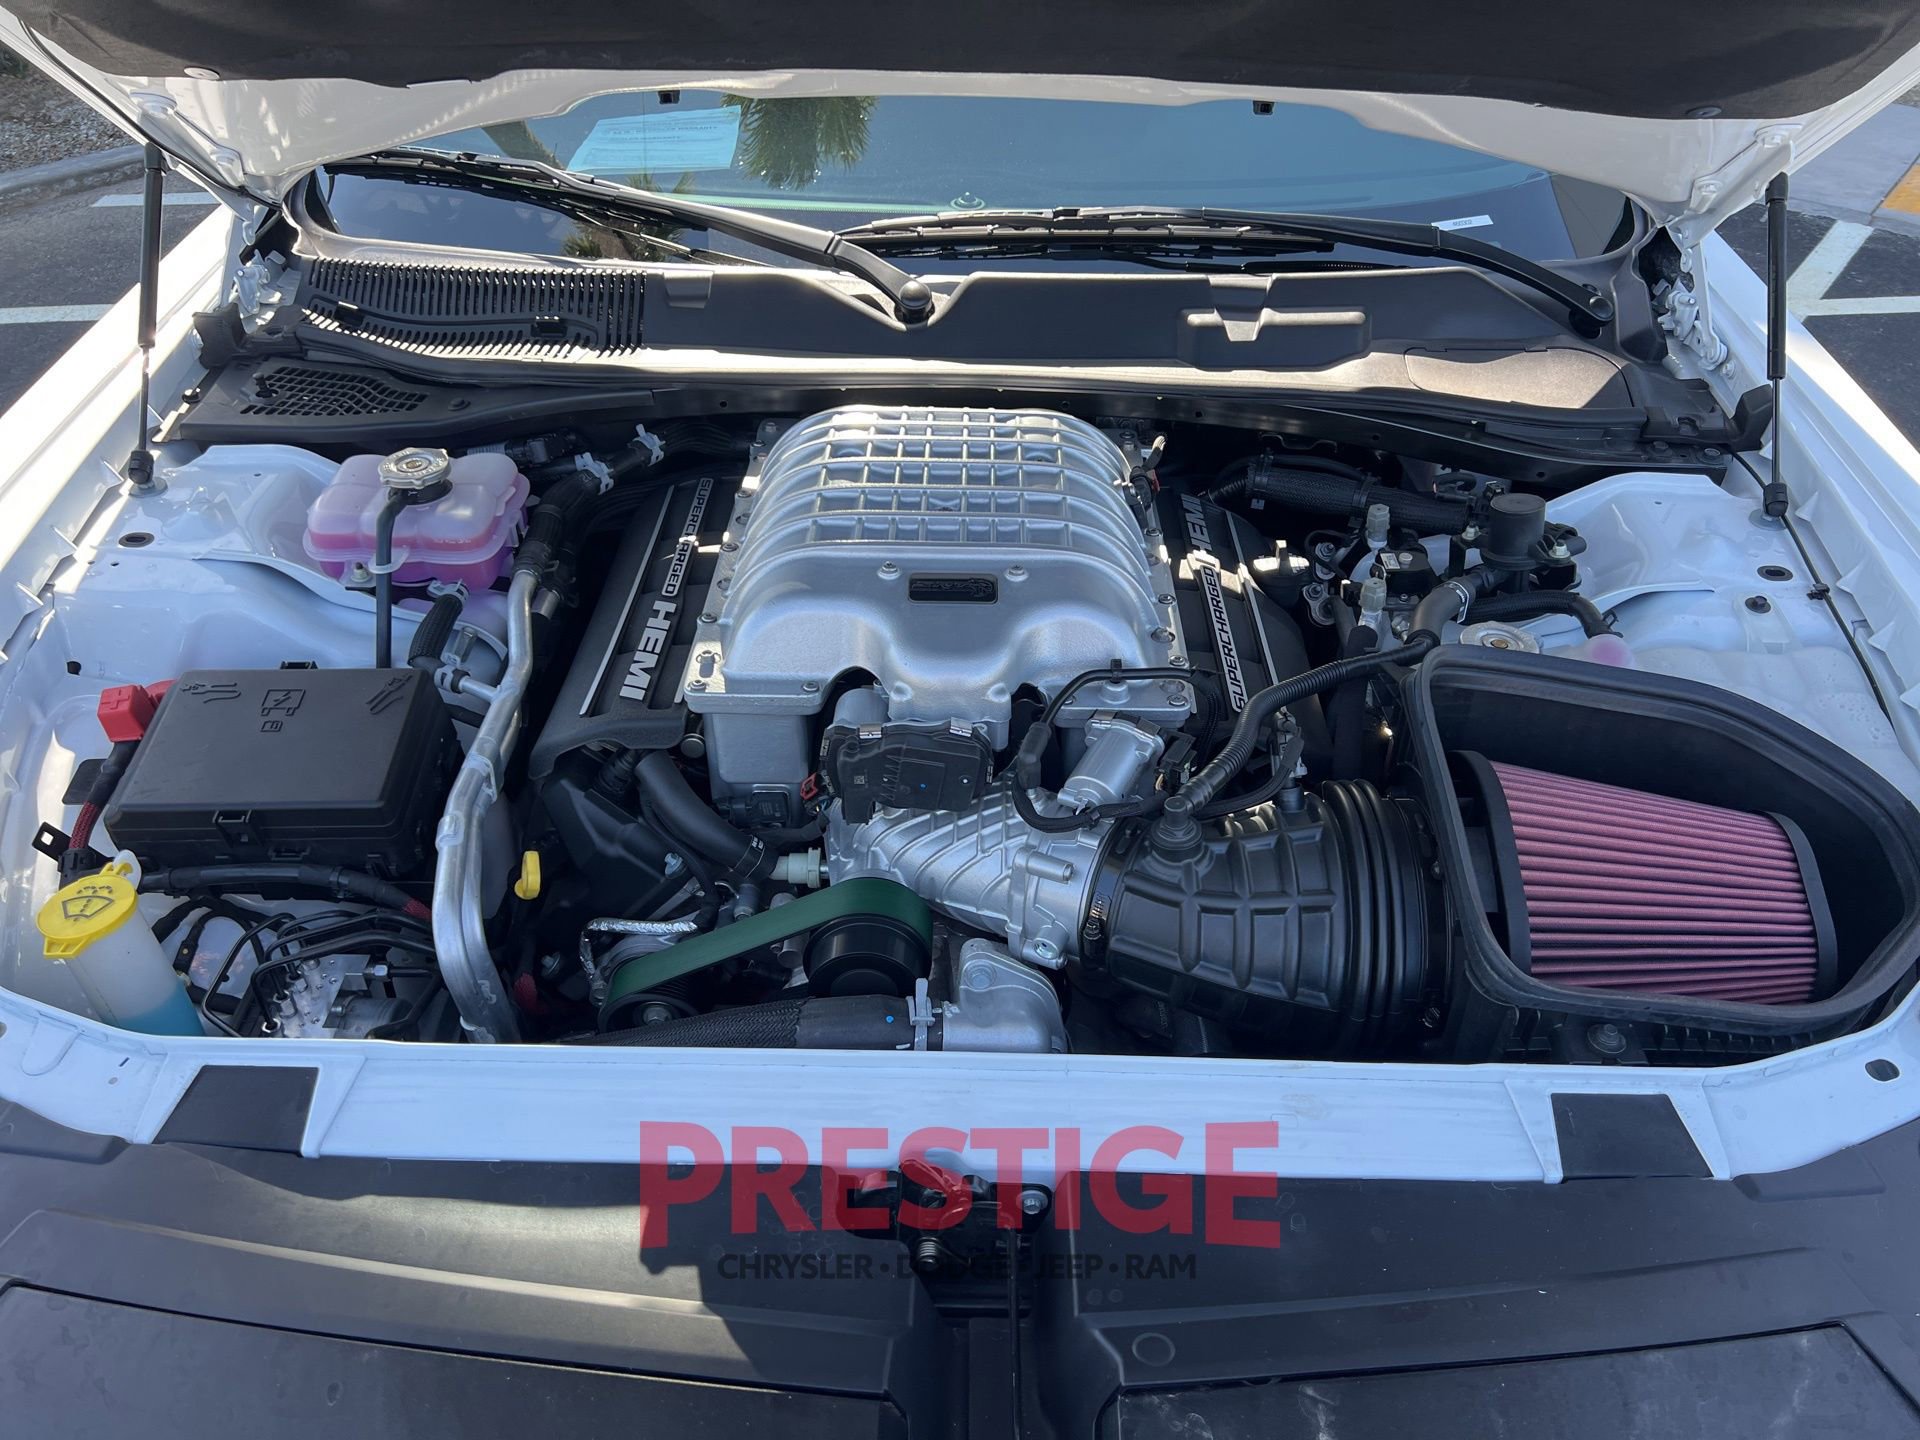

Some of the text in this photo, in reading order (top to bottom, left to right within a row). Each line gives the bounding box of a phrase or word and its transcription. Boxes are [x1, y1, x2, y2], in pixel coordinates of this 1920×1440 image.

[619, 600, 677, 701] HEMI
[1181, 493, 1248, 711] SUPERCHARGED HEMI
